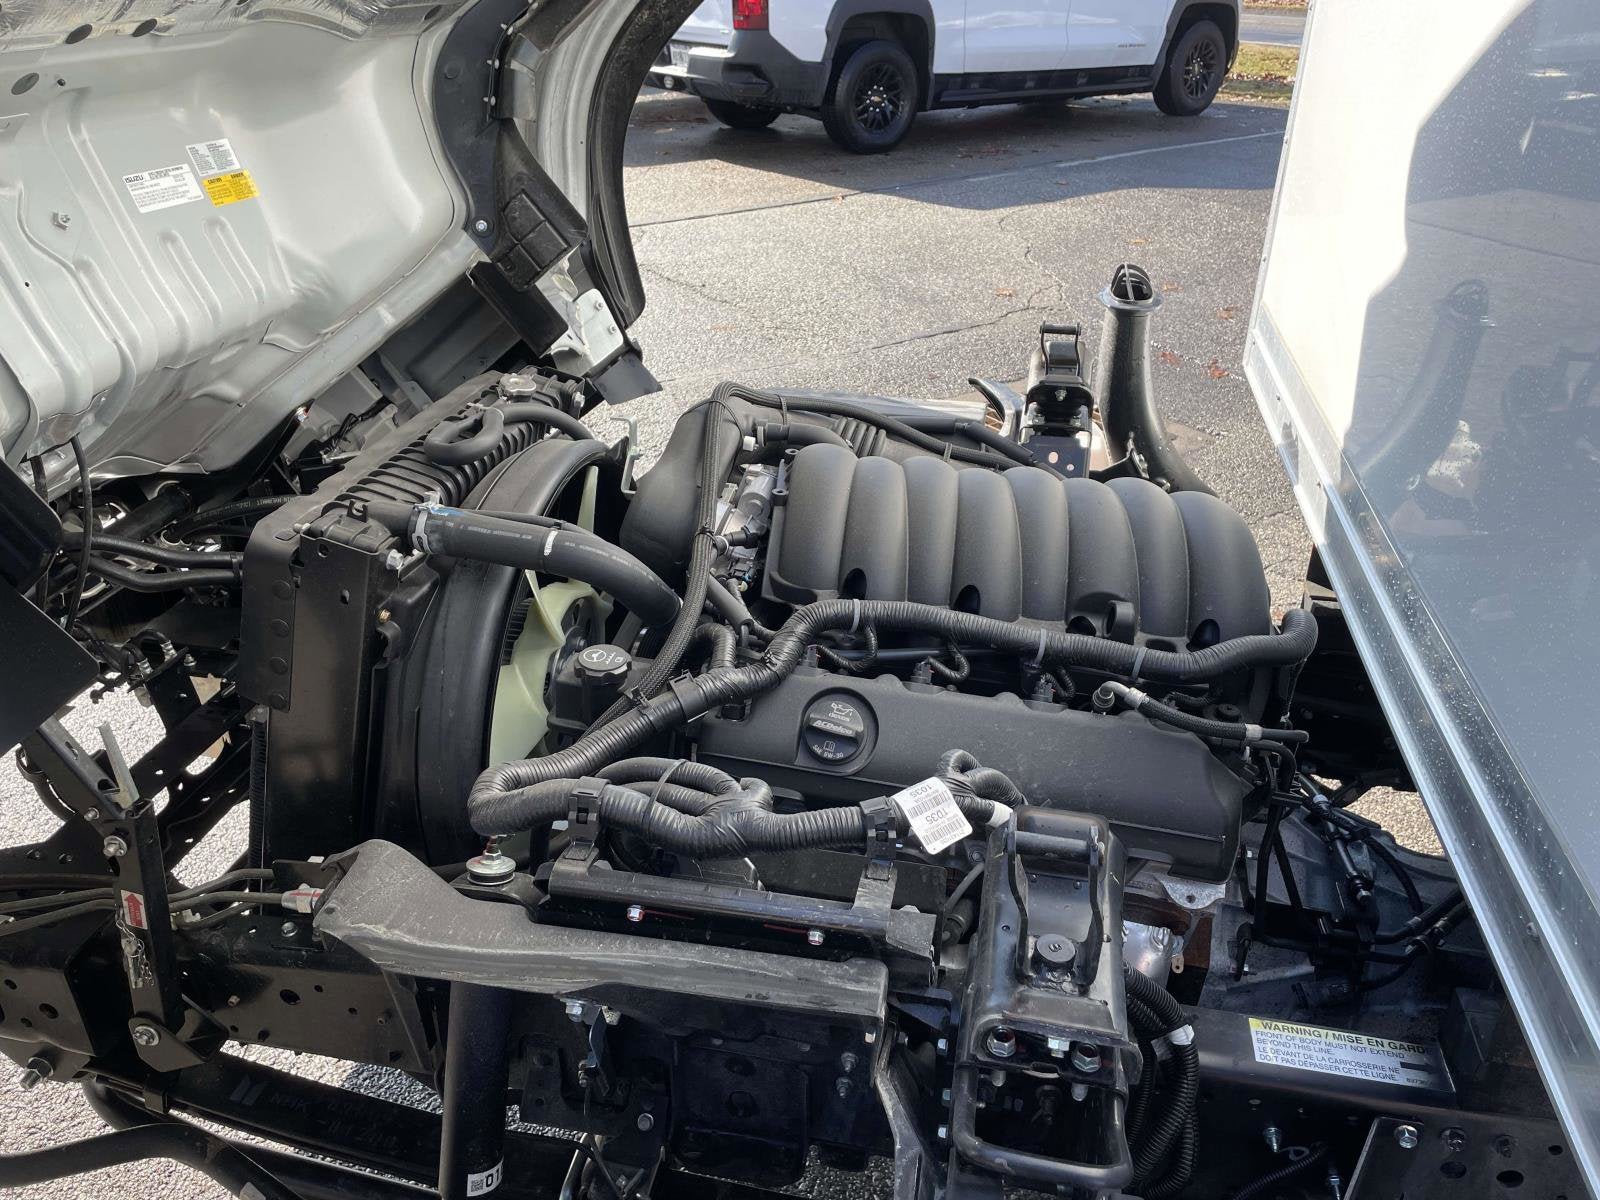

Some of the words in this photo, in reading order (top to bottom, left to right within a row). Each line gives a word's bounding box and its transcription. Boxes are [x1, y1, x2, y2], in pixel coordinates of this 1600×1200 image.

[813, 720, 853, 735] ACDelco
[1255, 1030, 1283, 1040] FRONT
[1285, 1034, 1296, 1042] OF
[1300, 1036, 1322, 1045] BODY
[1324, 1040, 1347, 1050] MUST
[1350, 1045, 1368, 1054] NOT
[1370, 1048, 1405, 1059] EXTEND
[1256, 1037, 1291, 1048] BEYOND
[1293, 1043, 1312, 1052] THIS
[1261, 1021, 1322, 1038] WARNING
[1332, 1032, 1364, 1045] MISE
[1367, 1038, 1385, 1048] EN
[1258, 1045, 1268, 1054] LE
[1269, 1047, 1301, 1058] DEVANT
[1303, 1052, 1314, 1061] DE
[1316, 1054, 1328, 1063] LA
[1328, 1056, 1388, 1072] CARROSSERIE
[1388, 1066, 1400, 1075] NE
[1281, 1057, 1297, 1066] PAS
[1342, 1066, 1372, 1077] CETTE
